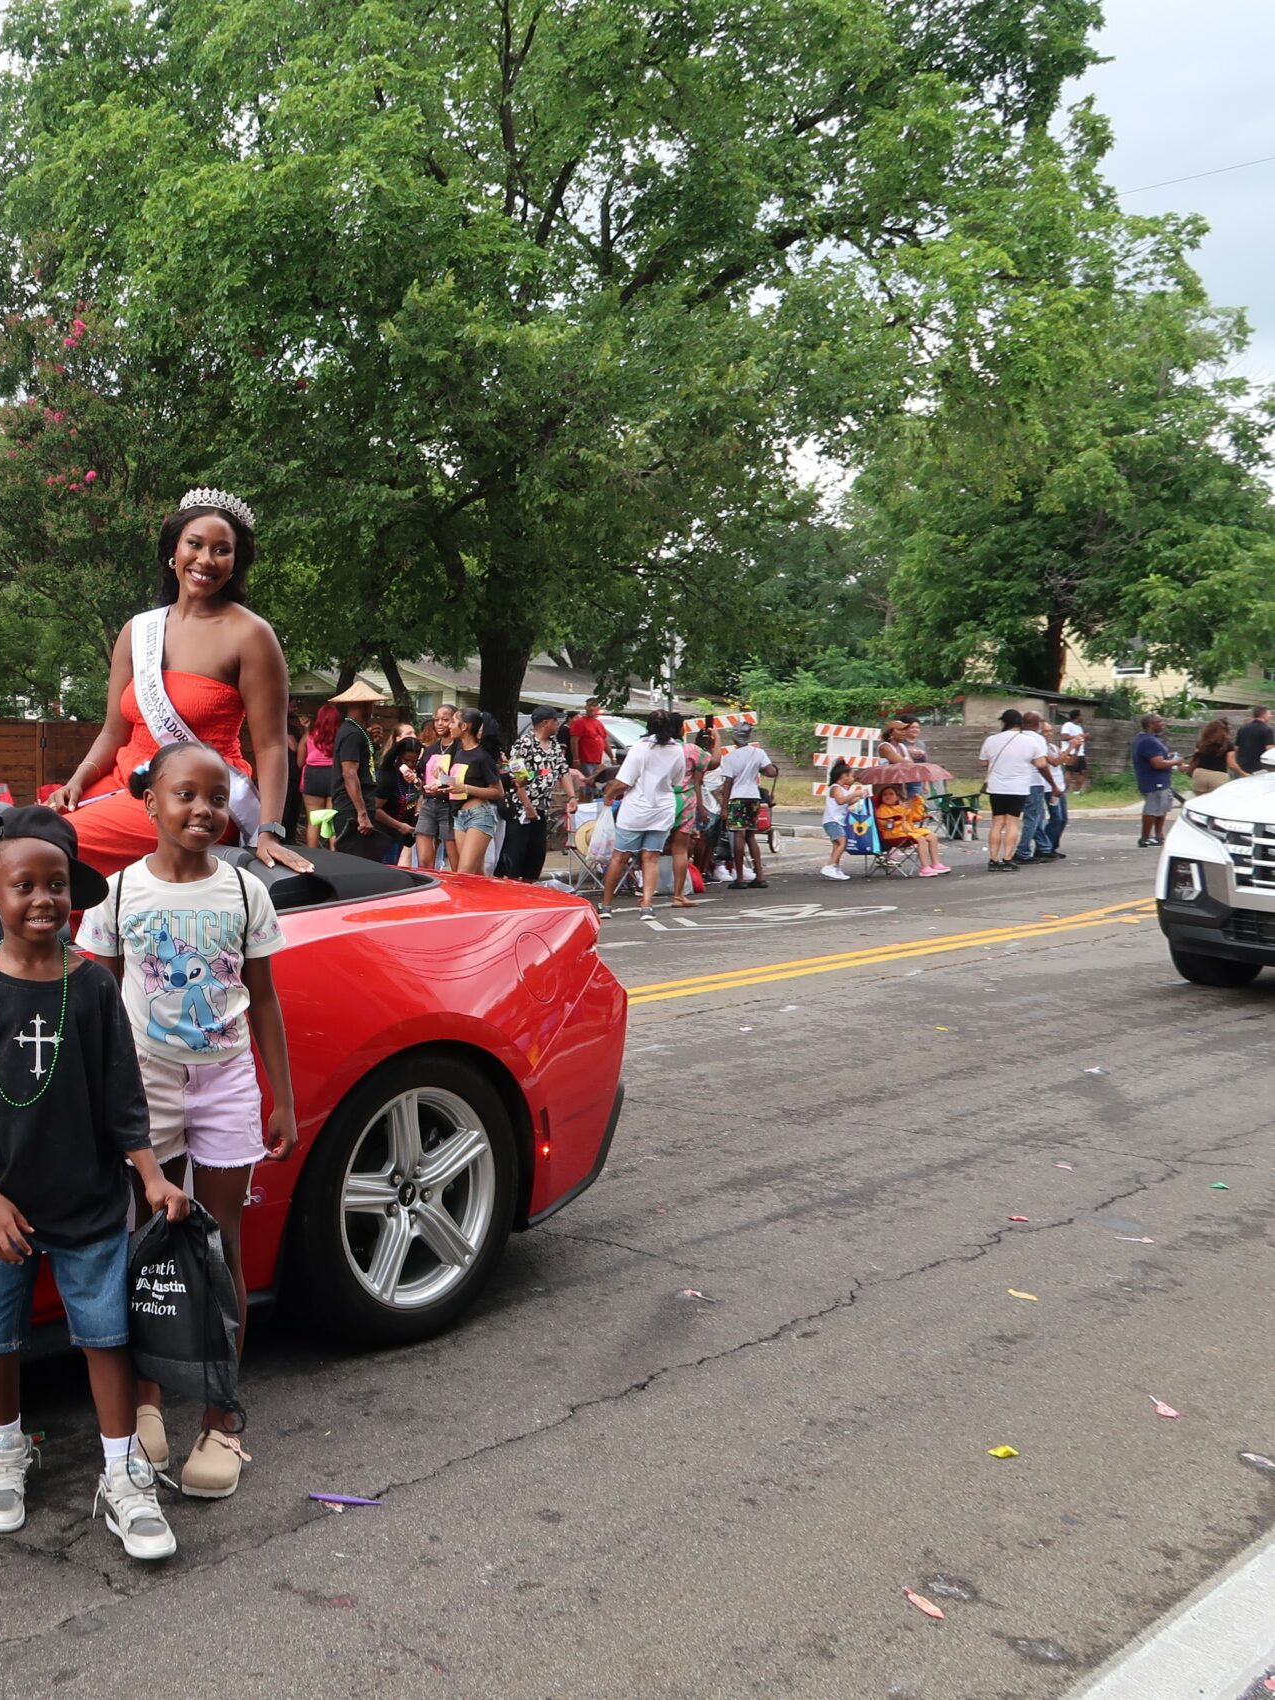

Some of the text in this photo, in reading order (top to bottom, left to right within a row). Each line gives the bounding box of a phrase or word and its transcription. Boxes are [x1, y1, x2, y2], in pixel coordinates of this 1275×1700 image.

[146, 621, 189, 742] CULTURAL AMBASSADOR
[151, 714, 163, 733] USA
[122, 910, 243, 957] STITCH
